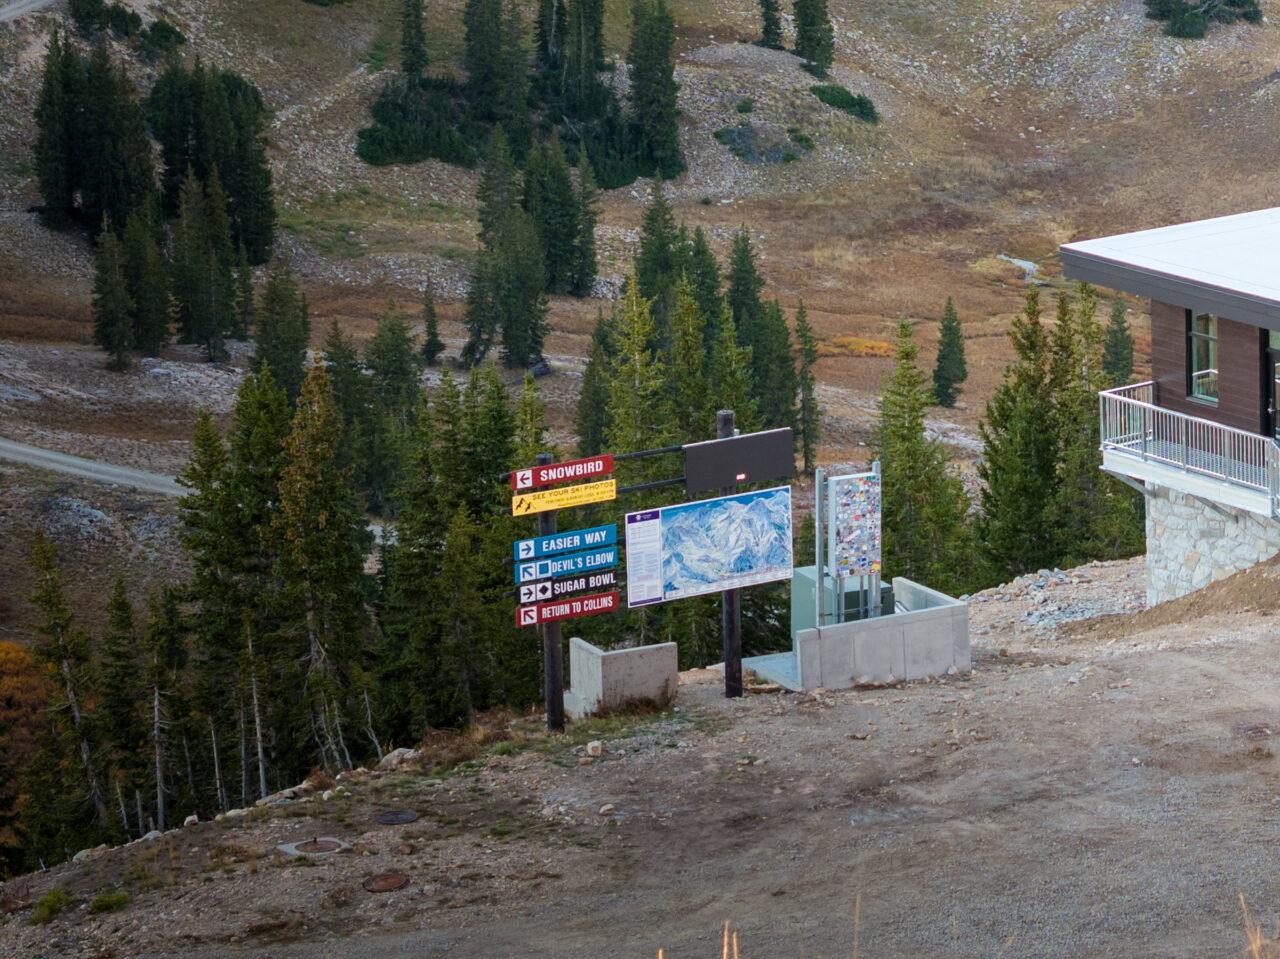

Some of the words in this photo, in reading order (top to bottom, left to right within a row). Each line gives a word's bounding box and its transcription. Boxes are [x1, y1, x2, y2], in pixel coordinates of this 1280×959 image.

[540, 460, 603, 482] SNOWBIRD
[532, 493, 545, 501] SEE
[549, 489, 569, 497] YOUR
[584, 481, 614, 491] PHOTOS
[542, 535, 580, 552] EASIER
[584, 530, 607, 545] WAY
[551, 557, 583, 573] DEVIL'S
[586, 551, 614, 567] ELBOW
[554, 578, 585, 594] SUGAR
[589, 572, 617, 588] BOWL
[542, 603, 570, 619] RETURN
[572, 601, 580, 613] TO
[583, 596, 613, 611] COLLINS
